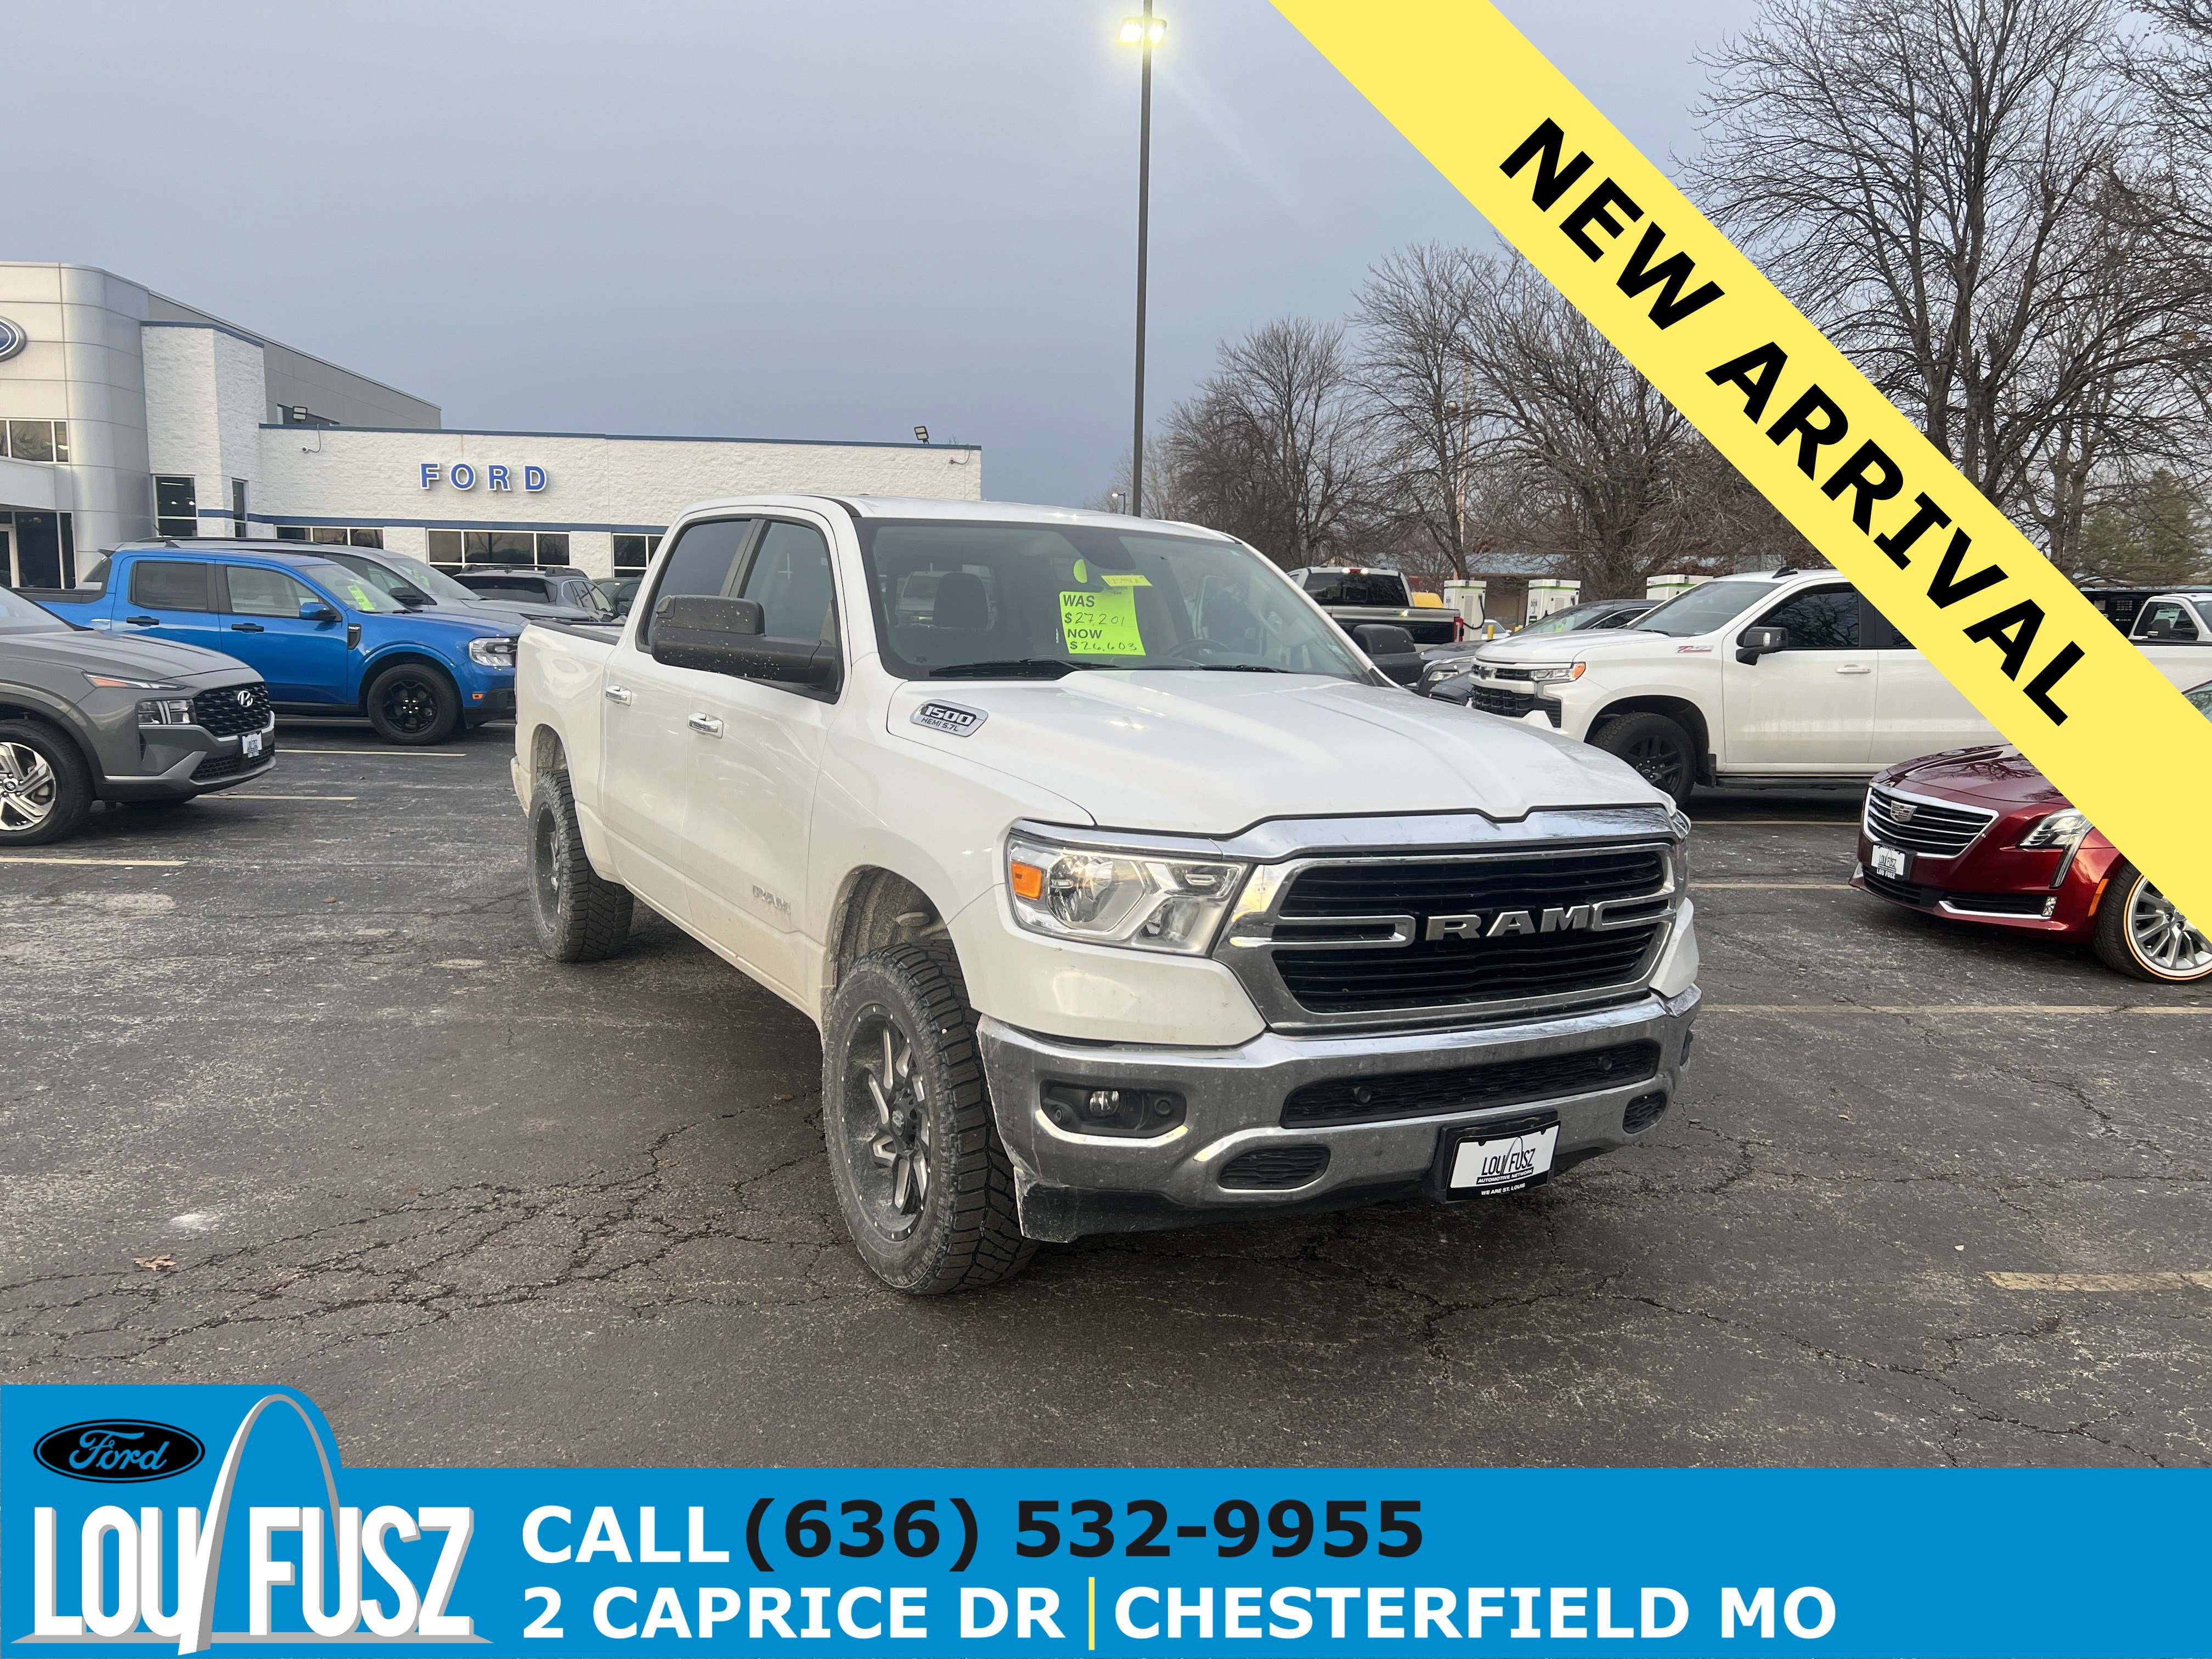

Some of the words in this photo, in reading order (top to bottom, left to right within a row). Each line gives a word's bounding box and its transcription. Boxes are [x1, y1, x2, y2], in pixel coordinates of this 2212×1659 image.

[420, 462, 546, 492] FORD
[1063, 595, 1094, 607] WAS
[1068, 629, 1102, 639] NOW
[921, 717, 941, 727] HEMI
[942, 723, 959, 732] 5.7L
[925, 706, 973, 725] 1500
[753, 884, 791, 915] RAM
[1425, 905, 1590, 941] RAM
[1481, 1155, 1506, 1175] LOU
[1509, 1148, 1536, 1172] FUSZ
[1478, 1175, 1510, 1183] AUTOMOTIVE
[1511, 1169, 1533, 1178] NETWORK
